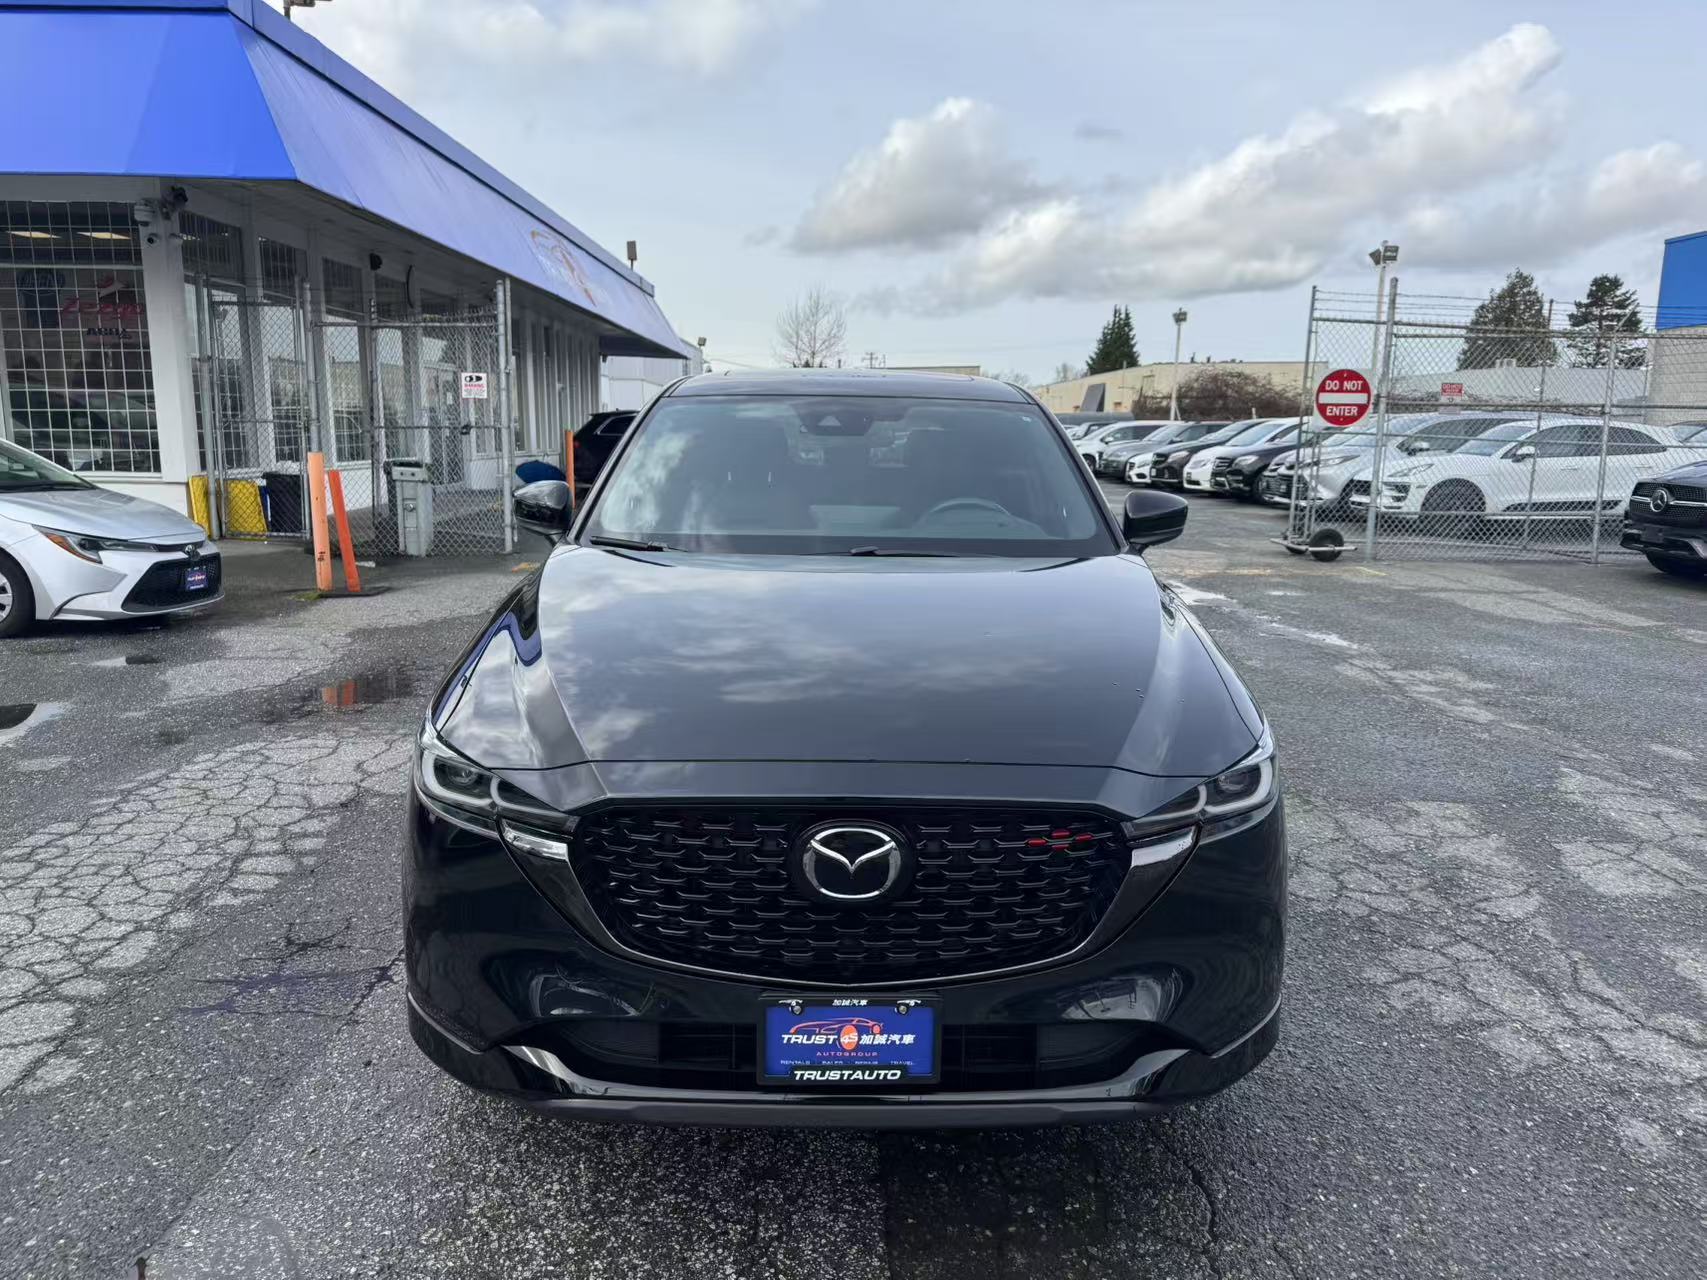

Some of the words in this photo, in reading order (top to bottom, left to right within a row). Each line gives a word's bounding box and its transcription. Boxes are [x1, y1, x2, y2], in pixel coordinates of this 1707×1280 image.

[1325, 380, 1339, 391] DO
[1343, 380, 1363, 391] NOT
[1326, 406, 1359, 417] ENTER
[781, 1034, 838, 1045] TRUST
[793, 1070, 901, 1080] TRUSTAUTO
